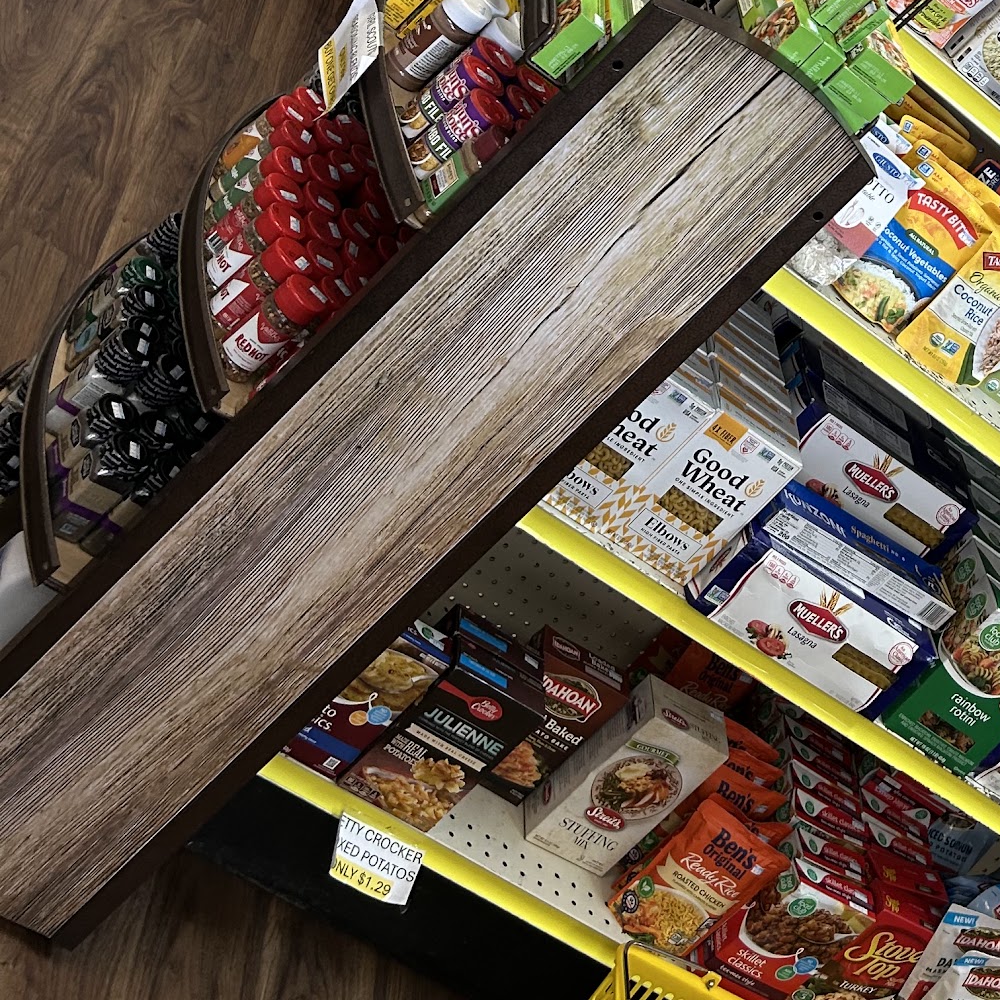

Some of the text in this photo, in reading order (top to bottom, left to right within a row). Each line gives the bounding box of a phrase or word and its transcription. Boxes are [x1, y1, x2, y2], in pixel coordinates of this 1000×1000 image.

[915, 189, 951, 222] TASTY
[213, 255, 232, 273] HOT
[908, 247, 948, 283] Vegetables
[951, 282, 994, 317] Coconut
[964, 306, 985, 326] Rice
[719, 428, 737, 444] FIBER
[691, 444, 748, 491] Good
[846, 463, 896, 500] MUELLER'S
[679, 459, 747, 514] Wheat
[841, 485, 871, 509] Lasagna
[704, 497, 734, 519] INGREDIENT
[644, 515, 690, 552] Elbows
[791, 601, 845, 641] MUELLER'S
[785, 625, 818, 651] Lasagna
[983, 632, 1000, 646] club
[948, 703, 979, 727] rotini
[949, 691, 993, 723] rainbow
[423, 704, 504, 757] JULIENNE
[544, 718, 583, 746] Baked
[363, 828, 424, 865] CROCKER
[558, 817, 618, 851] STUFFING
[572, 837, 589, 849] MIX
[708, 825, 763, 872] Ben's
[359, 849, 416, 884] POTATOS
[676, 848, 743, 900] Ready Rice
[699, 842, 748, 882] Original
[355, 870, 392, 897] $1.29
[670, 869, 726, 910] ROASTED CHICKEN
[726, 951, 764, 982] classics
[735, 945, 767, 970] skillet
[856, 955, 896, 988] Top
[840, 976, 876, 1000] TURKEY
